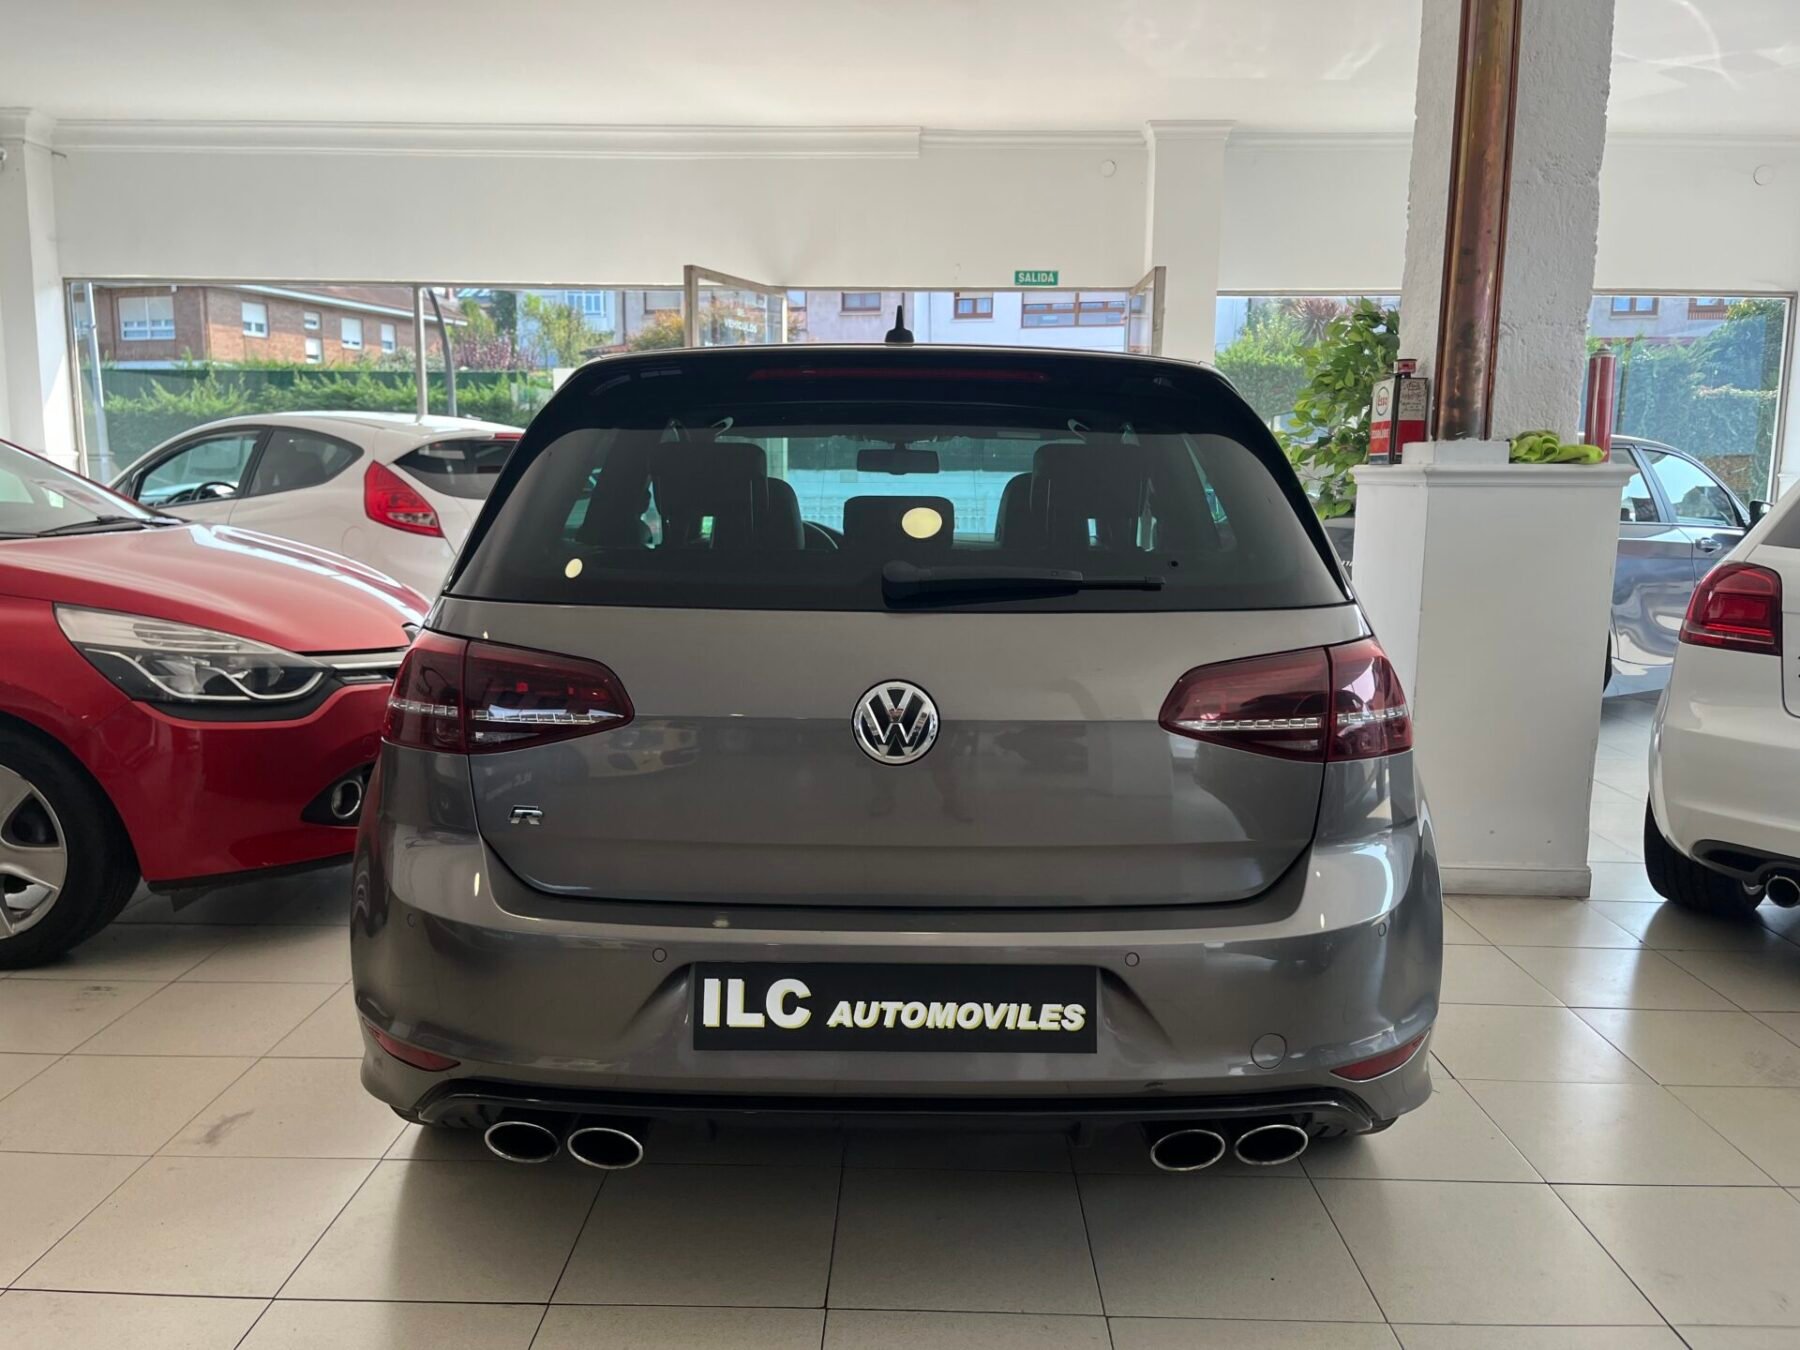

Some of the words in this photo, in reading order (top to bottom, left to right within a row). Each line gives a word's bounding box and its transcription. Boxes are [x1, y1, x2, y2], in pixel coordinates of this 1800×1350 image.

[1018, 272, 1055, 283] SALIDA
[509, 804, 543, 825] R
[702, 977, 811, 1029] ILC
[826, 1000, 1087, 1031] AUTOMOVILES
